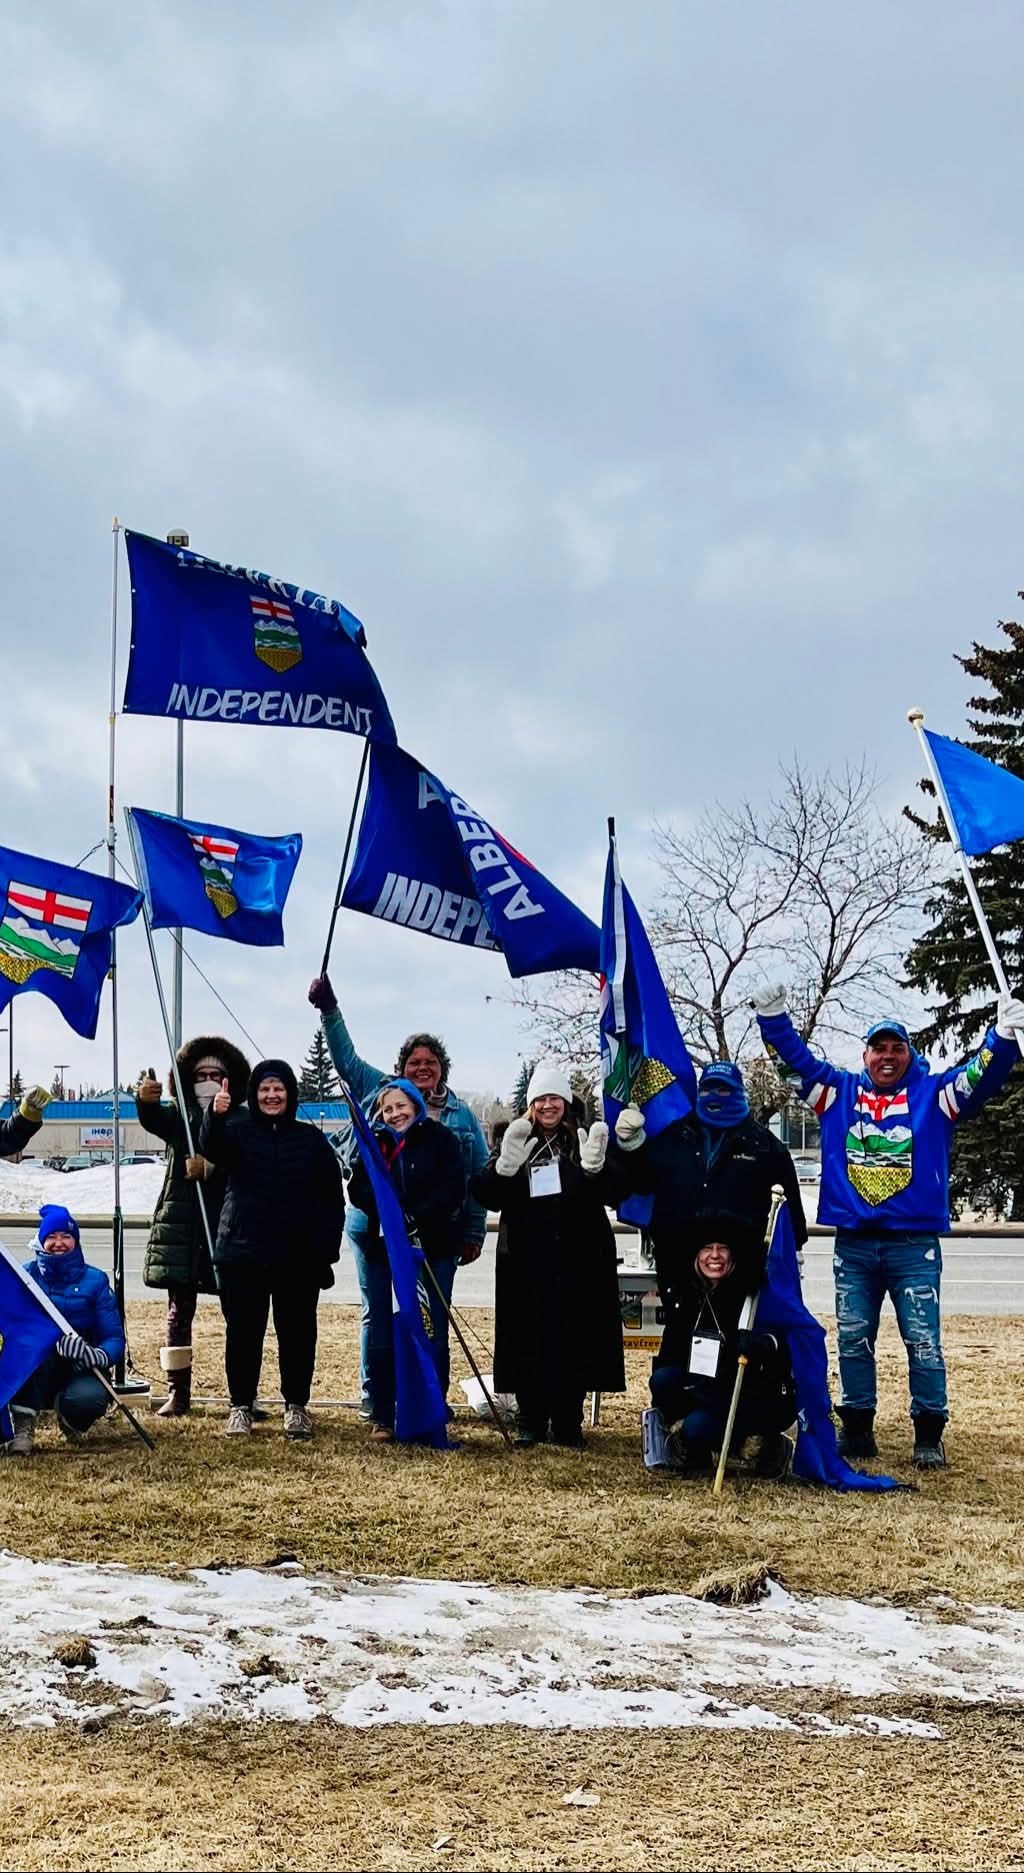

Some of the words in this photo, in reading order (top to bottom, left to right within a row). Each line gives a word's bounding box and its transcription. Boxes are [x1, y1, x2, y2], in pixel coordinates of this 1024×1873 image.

[165, 682, 375, 736] INDEPENDENT
[450, 788, 546, 921] ALBER
[372, 871, 502, 951] INDEPE
